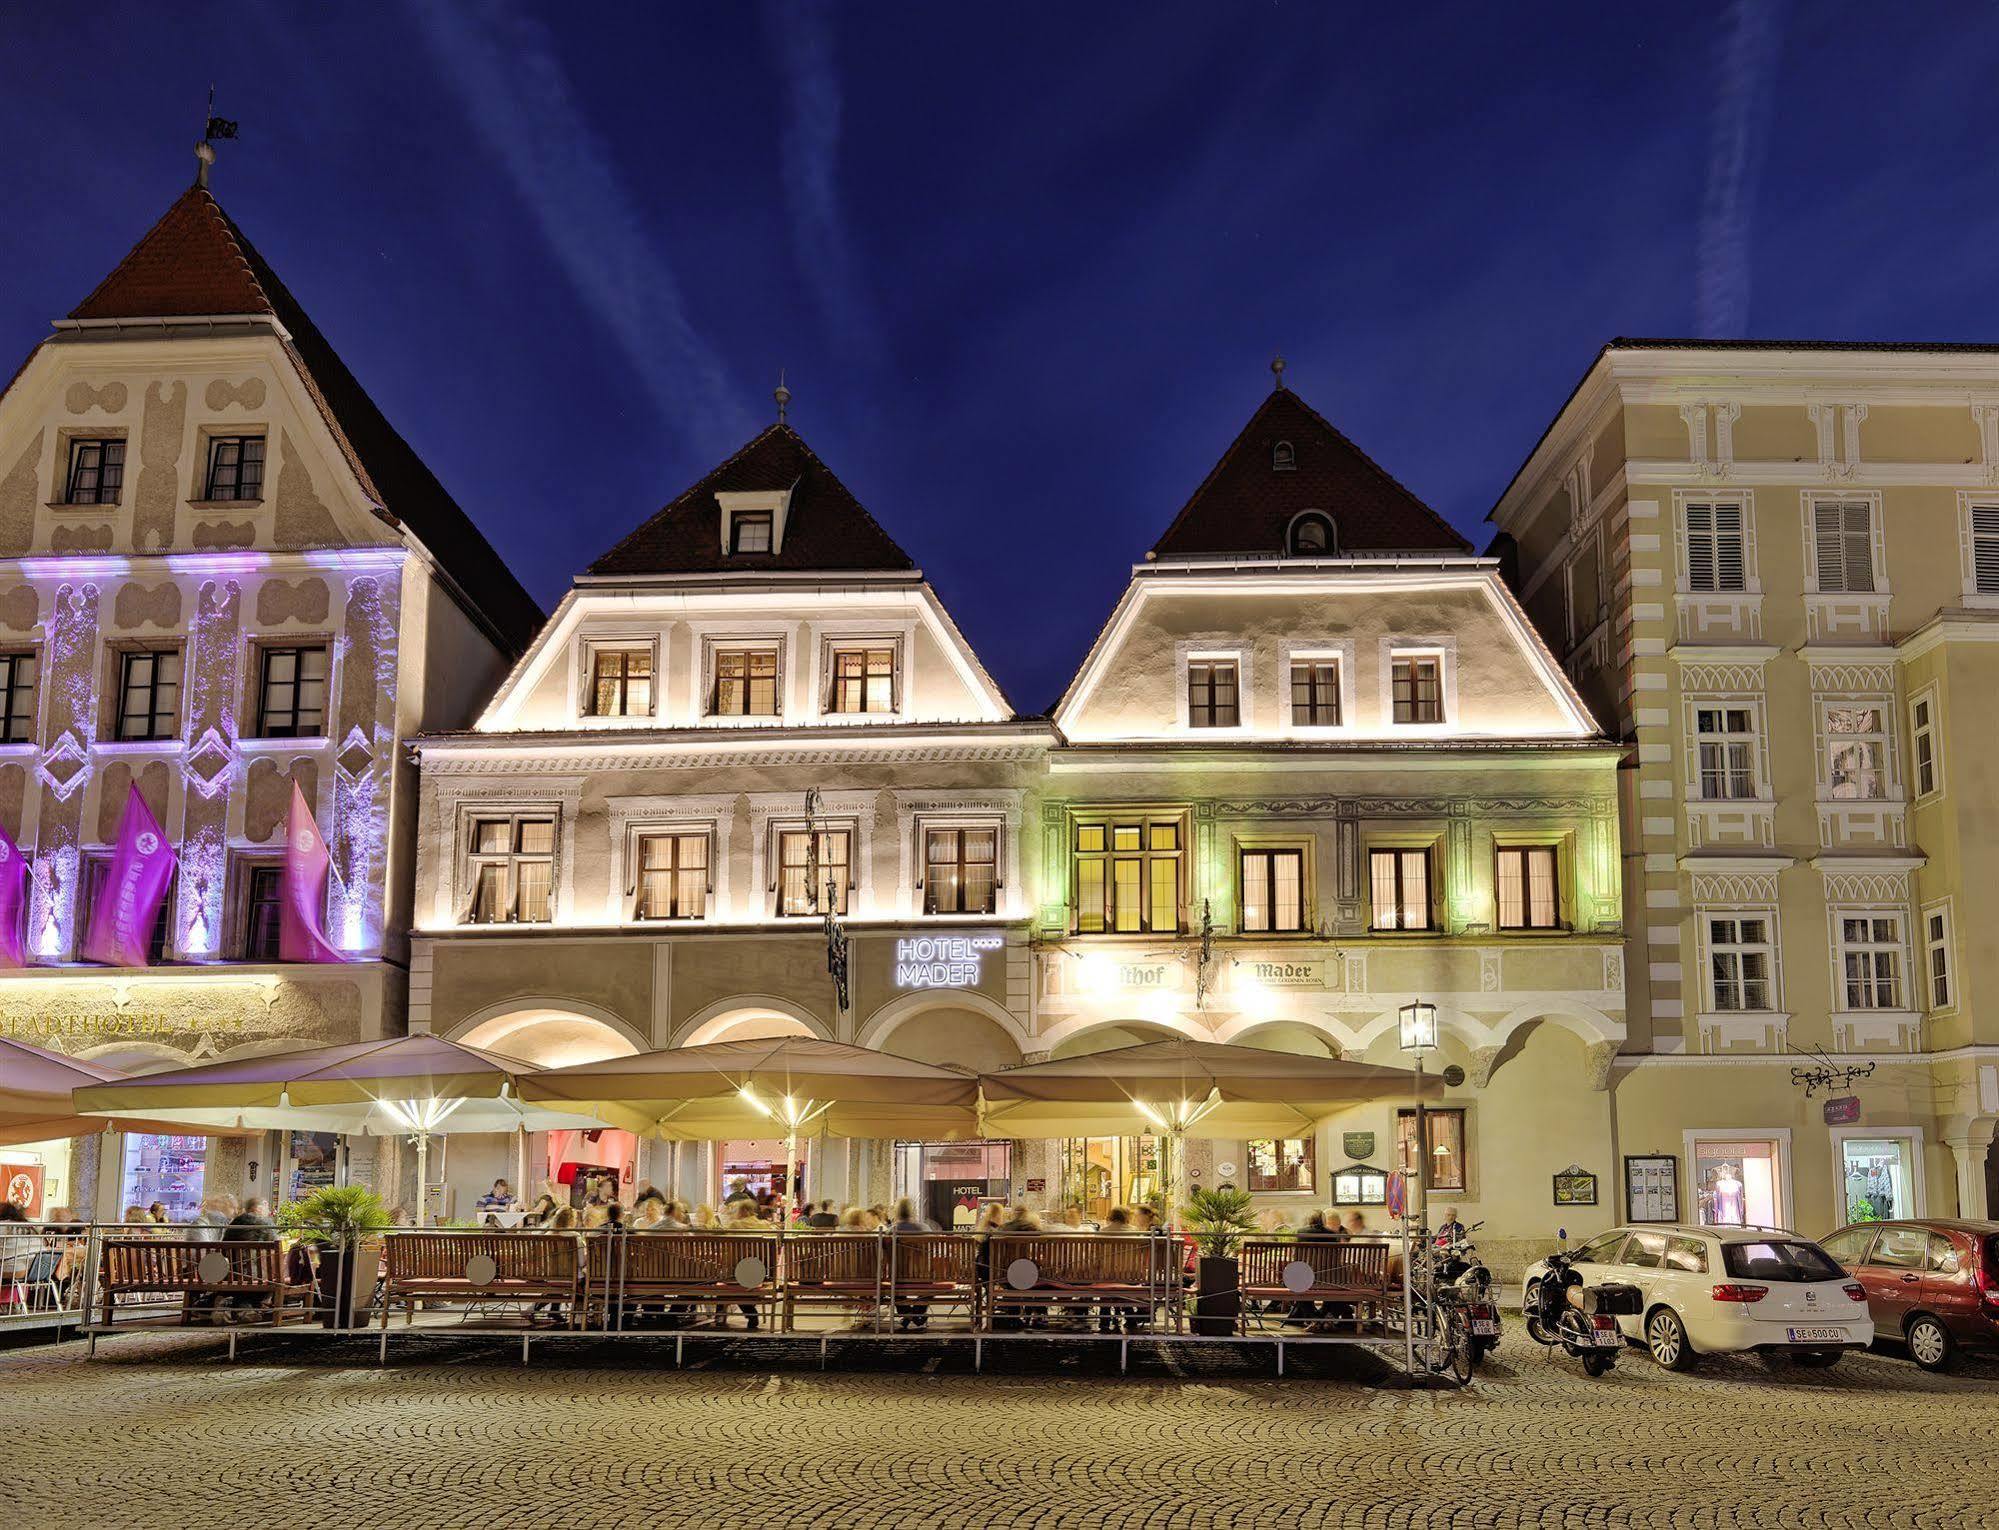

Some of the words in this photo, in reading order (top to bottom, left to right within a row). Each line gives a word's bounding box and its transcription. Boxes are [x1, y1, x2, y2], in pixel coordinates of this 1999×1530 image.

[898, 938, 980, 960] HOTEL
[897, 962, 978, 985] MADER
[1256, 963, 1312, 978] Mader
[0, 1012, 174, 1034] TADTHOTEL
[953, 1186, 983, 1195] HOTEL
